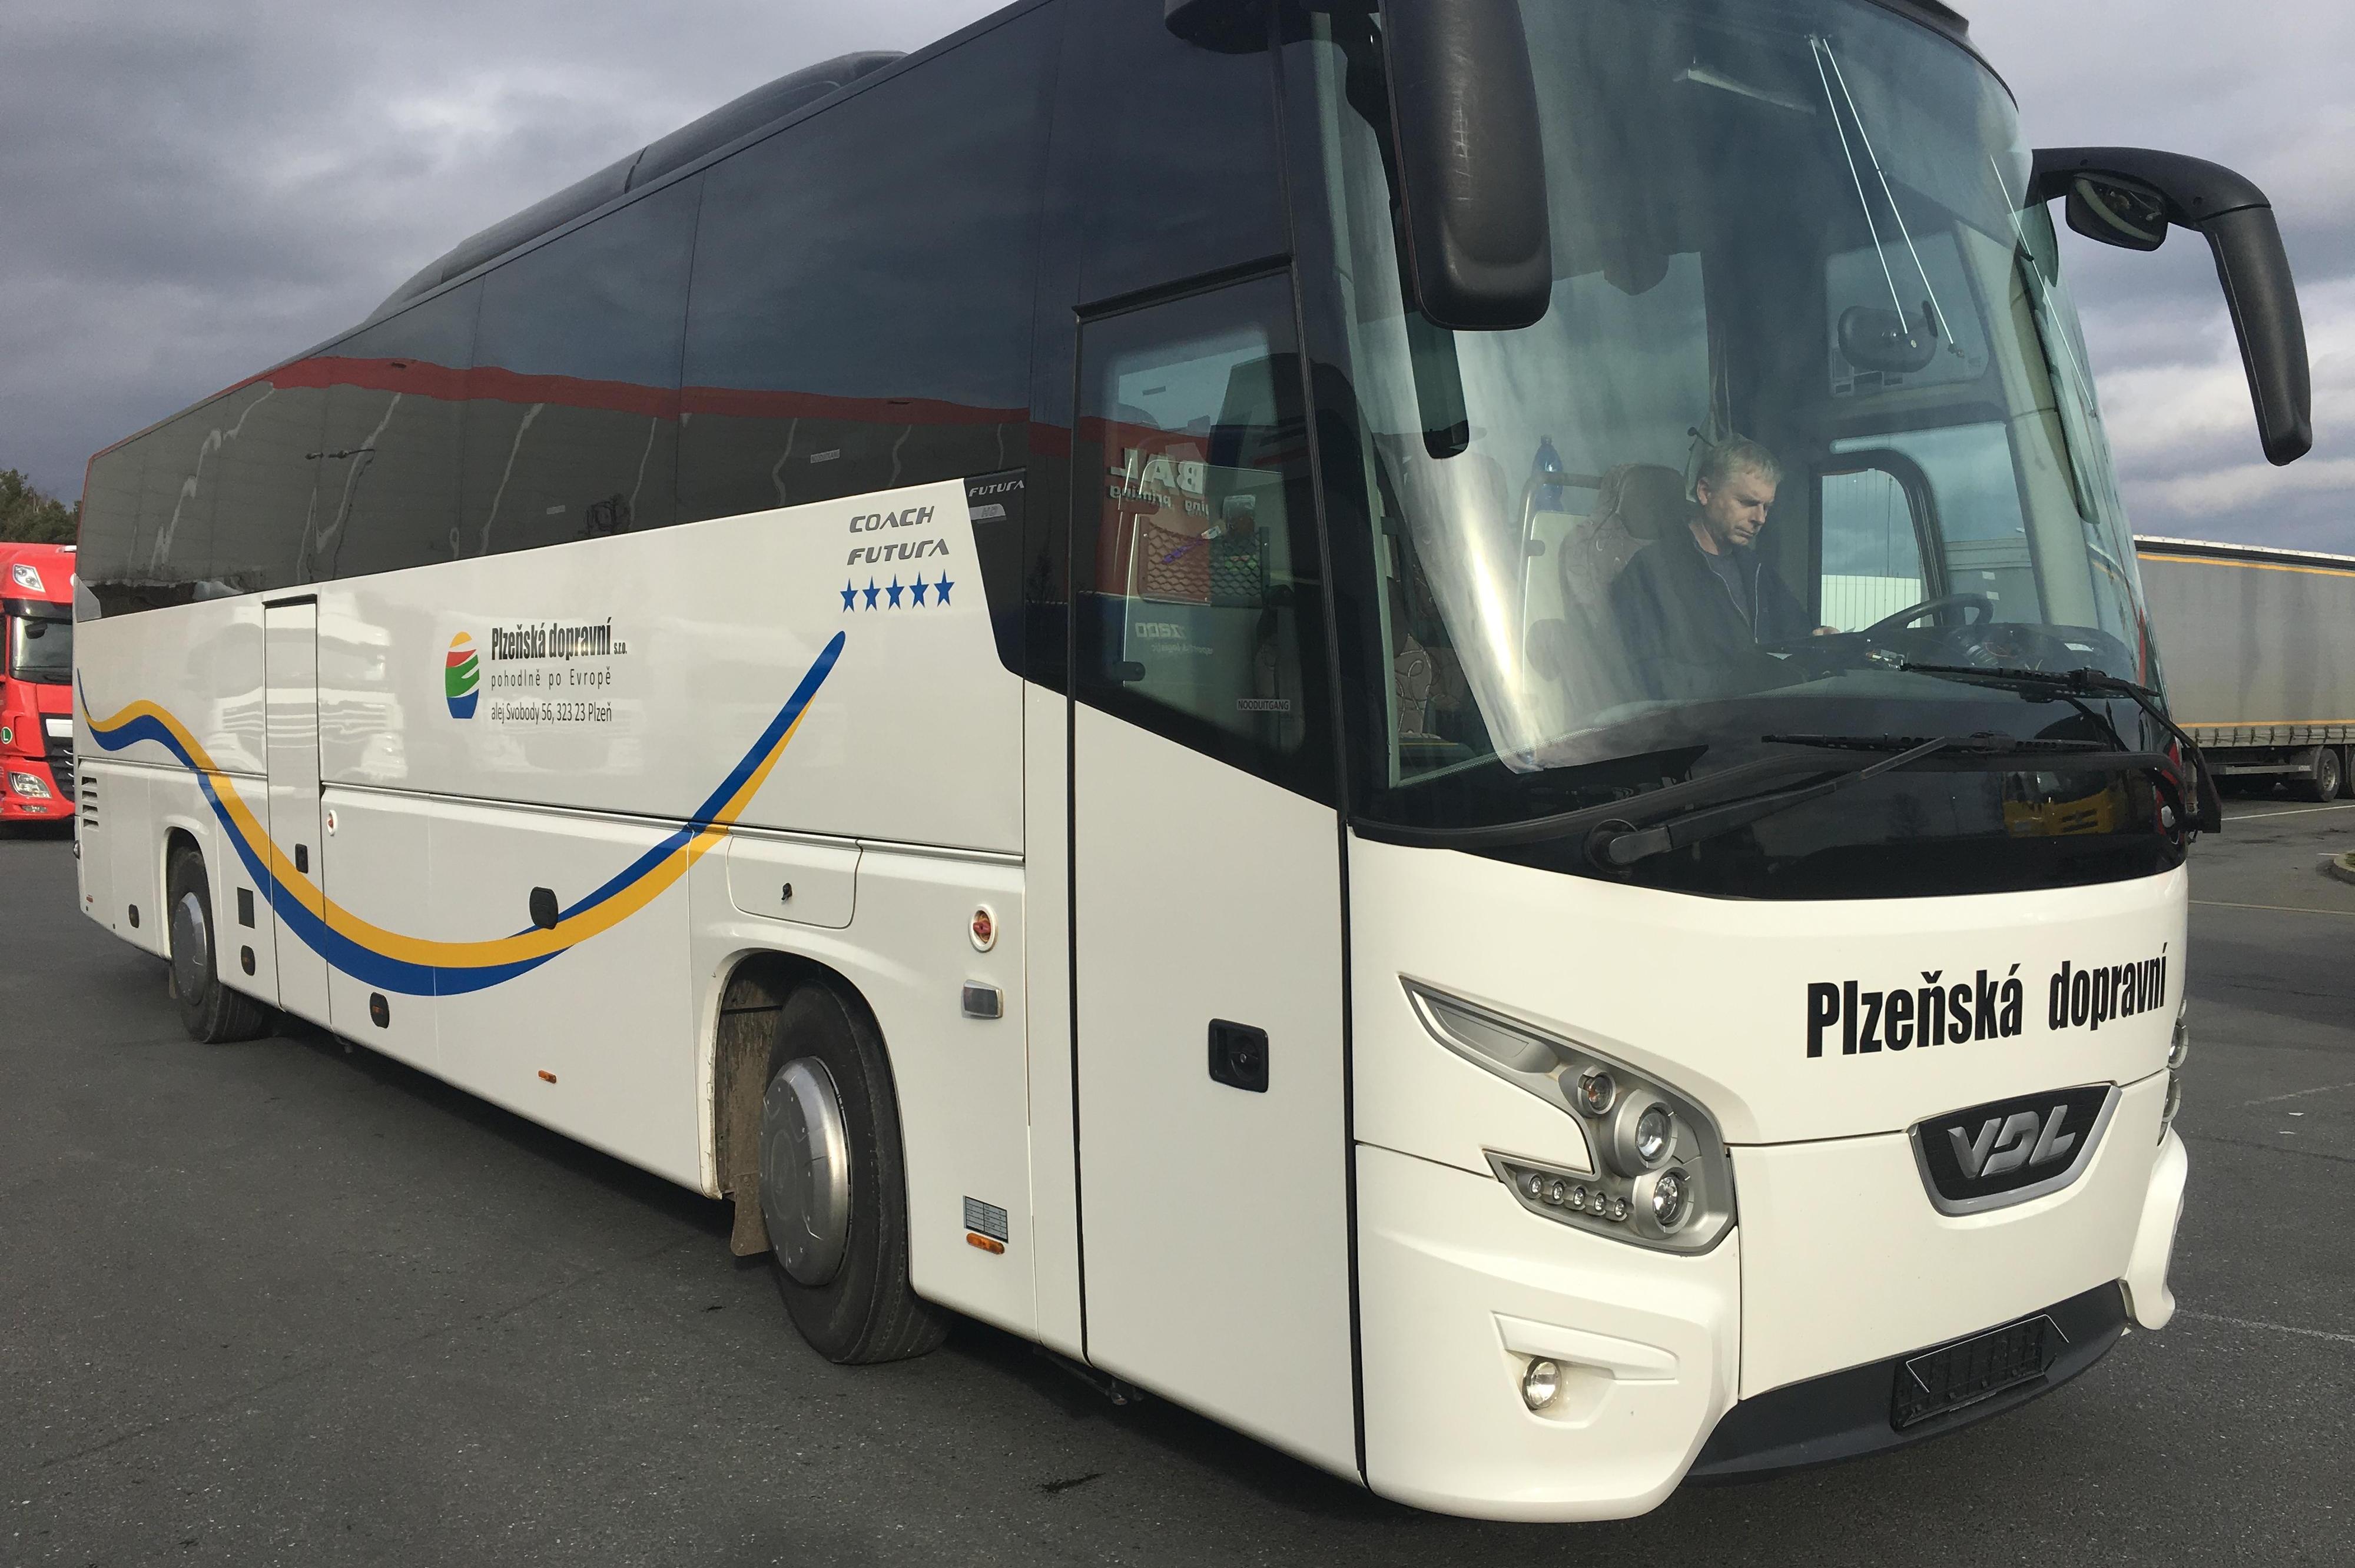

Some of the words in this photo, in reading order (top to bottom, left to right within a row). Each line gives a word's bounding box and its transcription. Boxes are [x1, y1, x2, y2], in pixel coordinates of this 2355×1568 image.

[968, 479, 1025, 497] FUTURA
[850, 506, 935, 533] COACH
[847, 539, 950, 566] FUTURA
[491, 622, 546, 660] Plzeňská
[549, 616, 612, 660] dopravní
[613, 642, 628, 655] s.r.o.
[491, 669, 541, 691] pohodlně
[549, 673, 562, 690] po
[570, 666, 612, 689] Evropě
[491, 702, 505, 724] alej
[506, 702, 540, 725] Svobody
[541, 703, 555, 725] 56,
[556, 703, 572, 722] 323
[575, 703, 586, 722] 23
[588, 701, 612, 722] Plzeň
[1238, 700, 1289, 710] NOODUITGANG
[1806, 963, 2024, 1058] Plzeňská
[2049, 942, 2168, 1031] dopravní
[1947, 1104, 2077, 1178] VDL
